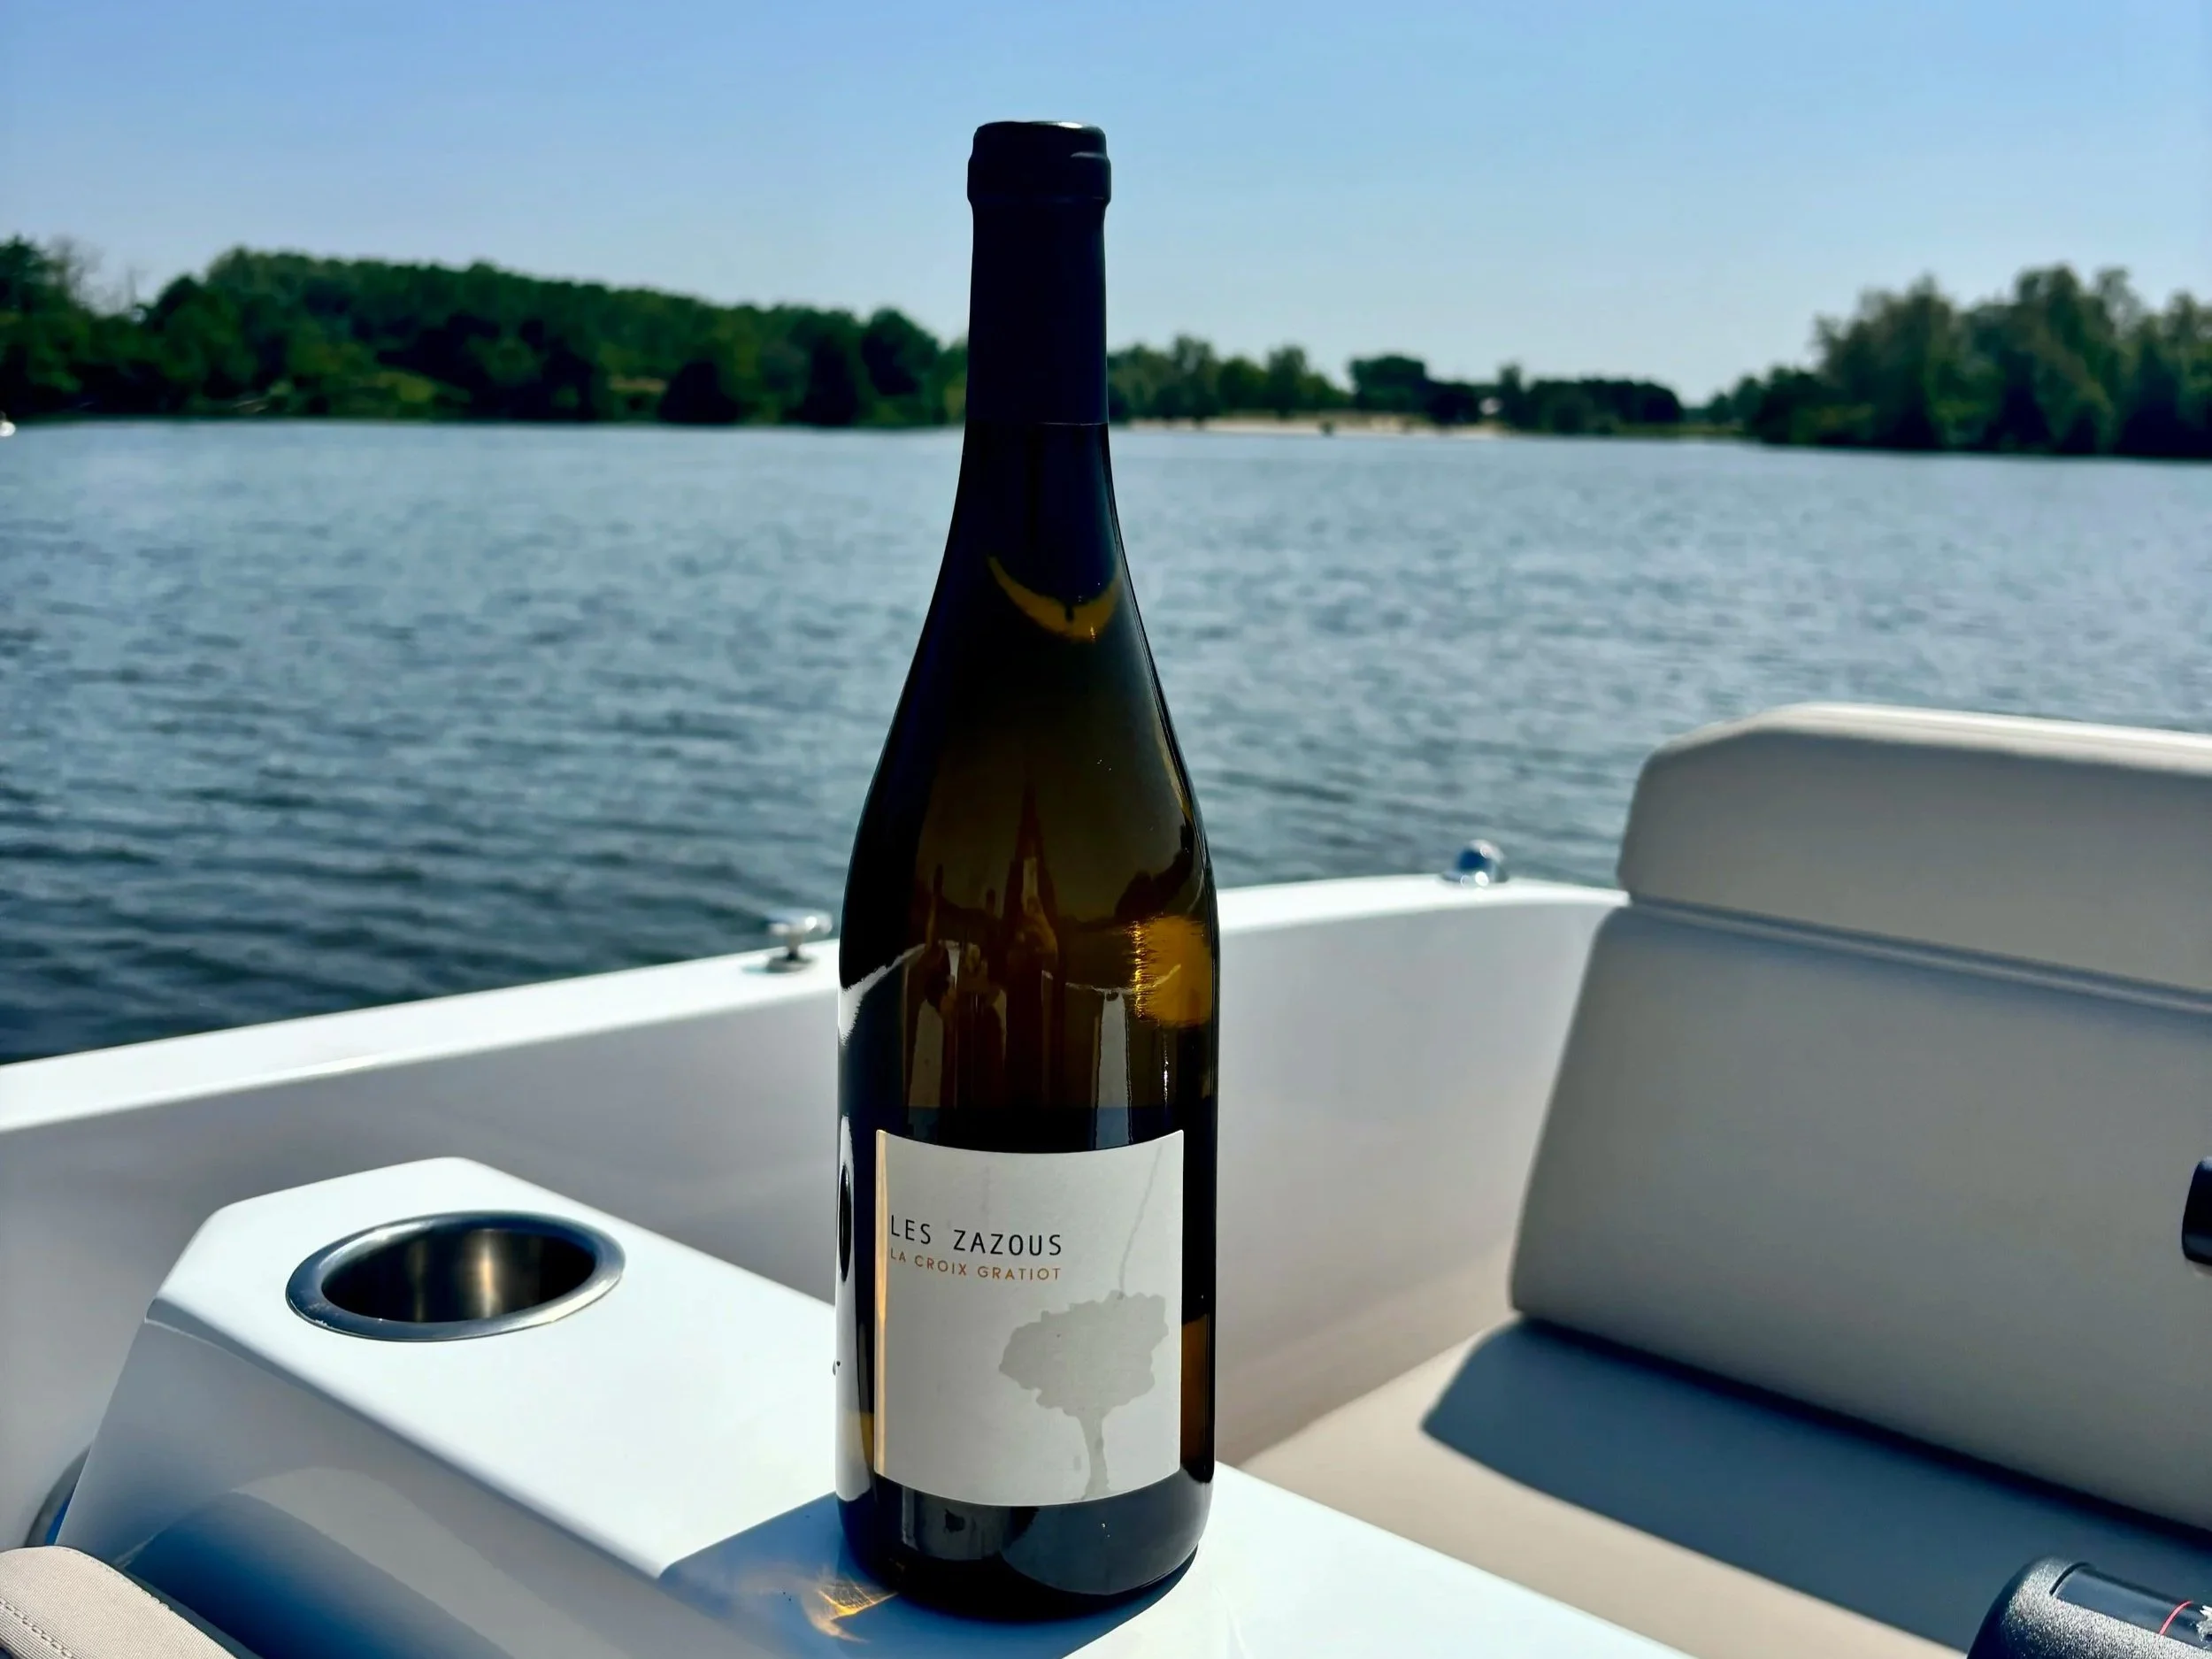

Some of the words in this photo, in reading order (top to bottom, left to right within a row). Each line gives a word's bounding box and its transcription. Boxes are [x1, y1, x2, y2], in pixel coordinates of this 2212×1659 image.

[891, 1215, 932, 1245] LES
[954, 1229, 1062, 1256] ZAZOUS
[890, 1248, 907, 1263] LA
[914, 1255, 968, 1276] CROIX
[977, 1265, 1062, 1280] GRATIOT
